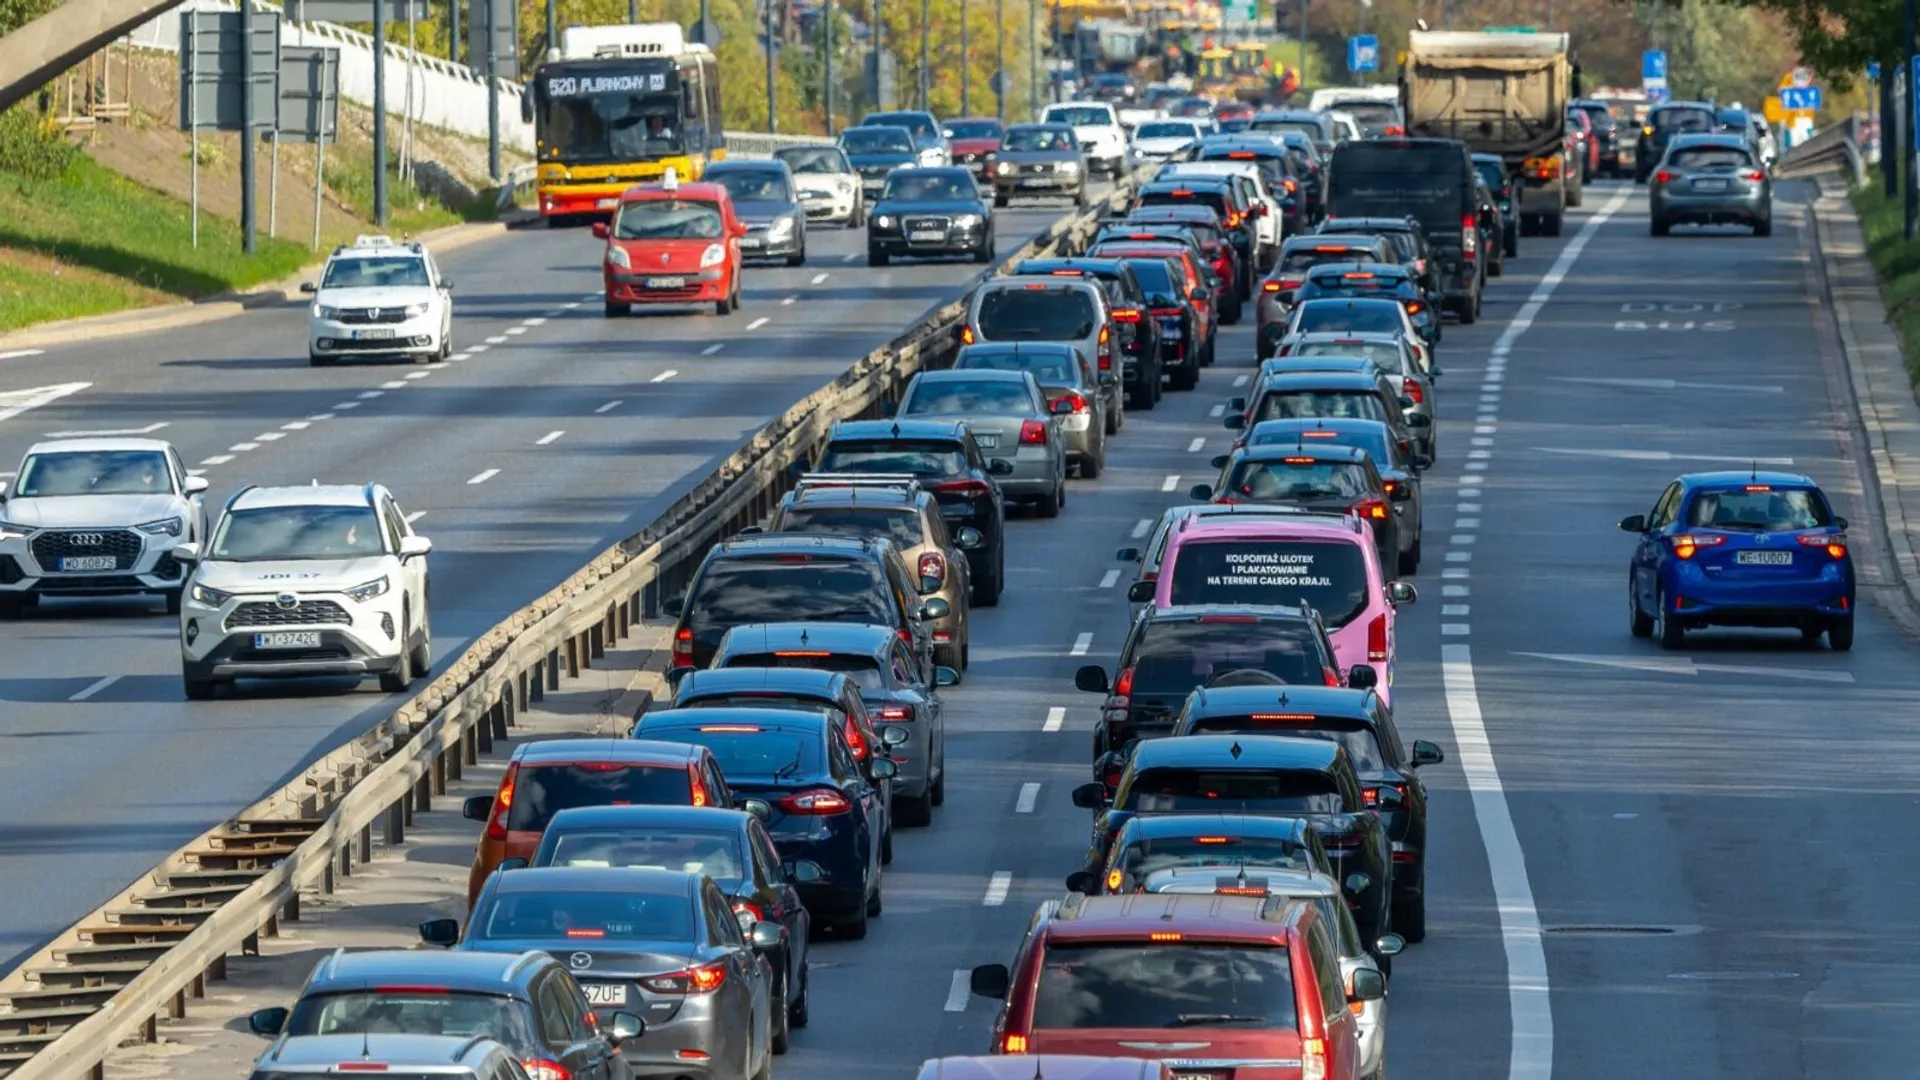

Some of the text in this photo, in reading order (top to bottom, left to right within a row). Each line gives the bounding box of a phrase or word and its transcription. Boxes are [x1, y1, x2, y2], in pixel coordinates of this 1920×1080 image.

[549, 77, 576, 96] 520
[1226, 552, 1314, 563] KOLPORTAŻ ULOTEK
[1237, 566, 1307, 574] PLAKATOWANIE
[1207, 576, 1332, 586] NA TERENIE CAŁEGO KRAJU.
